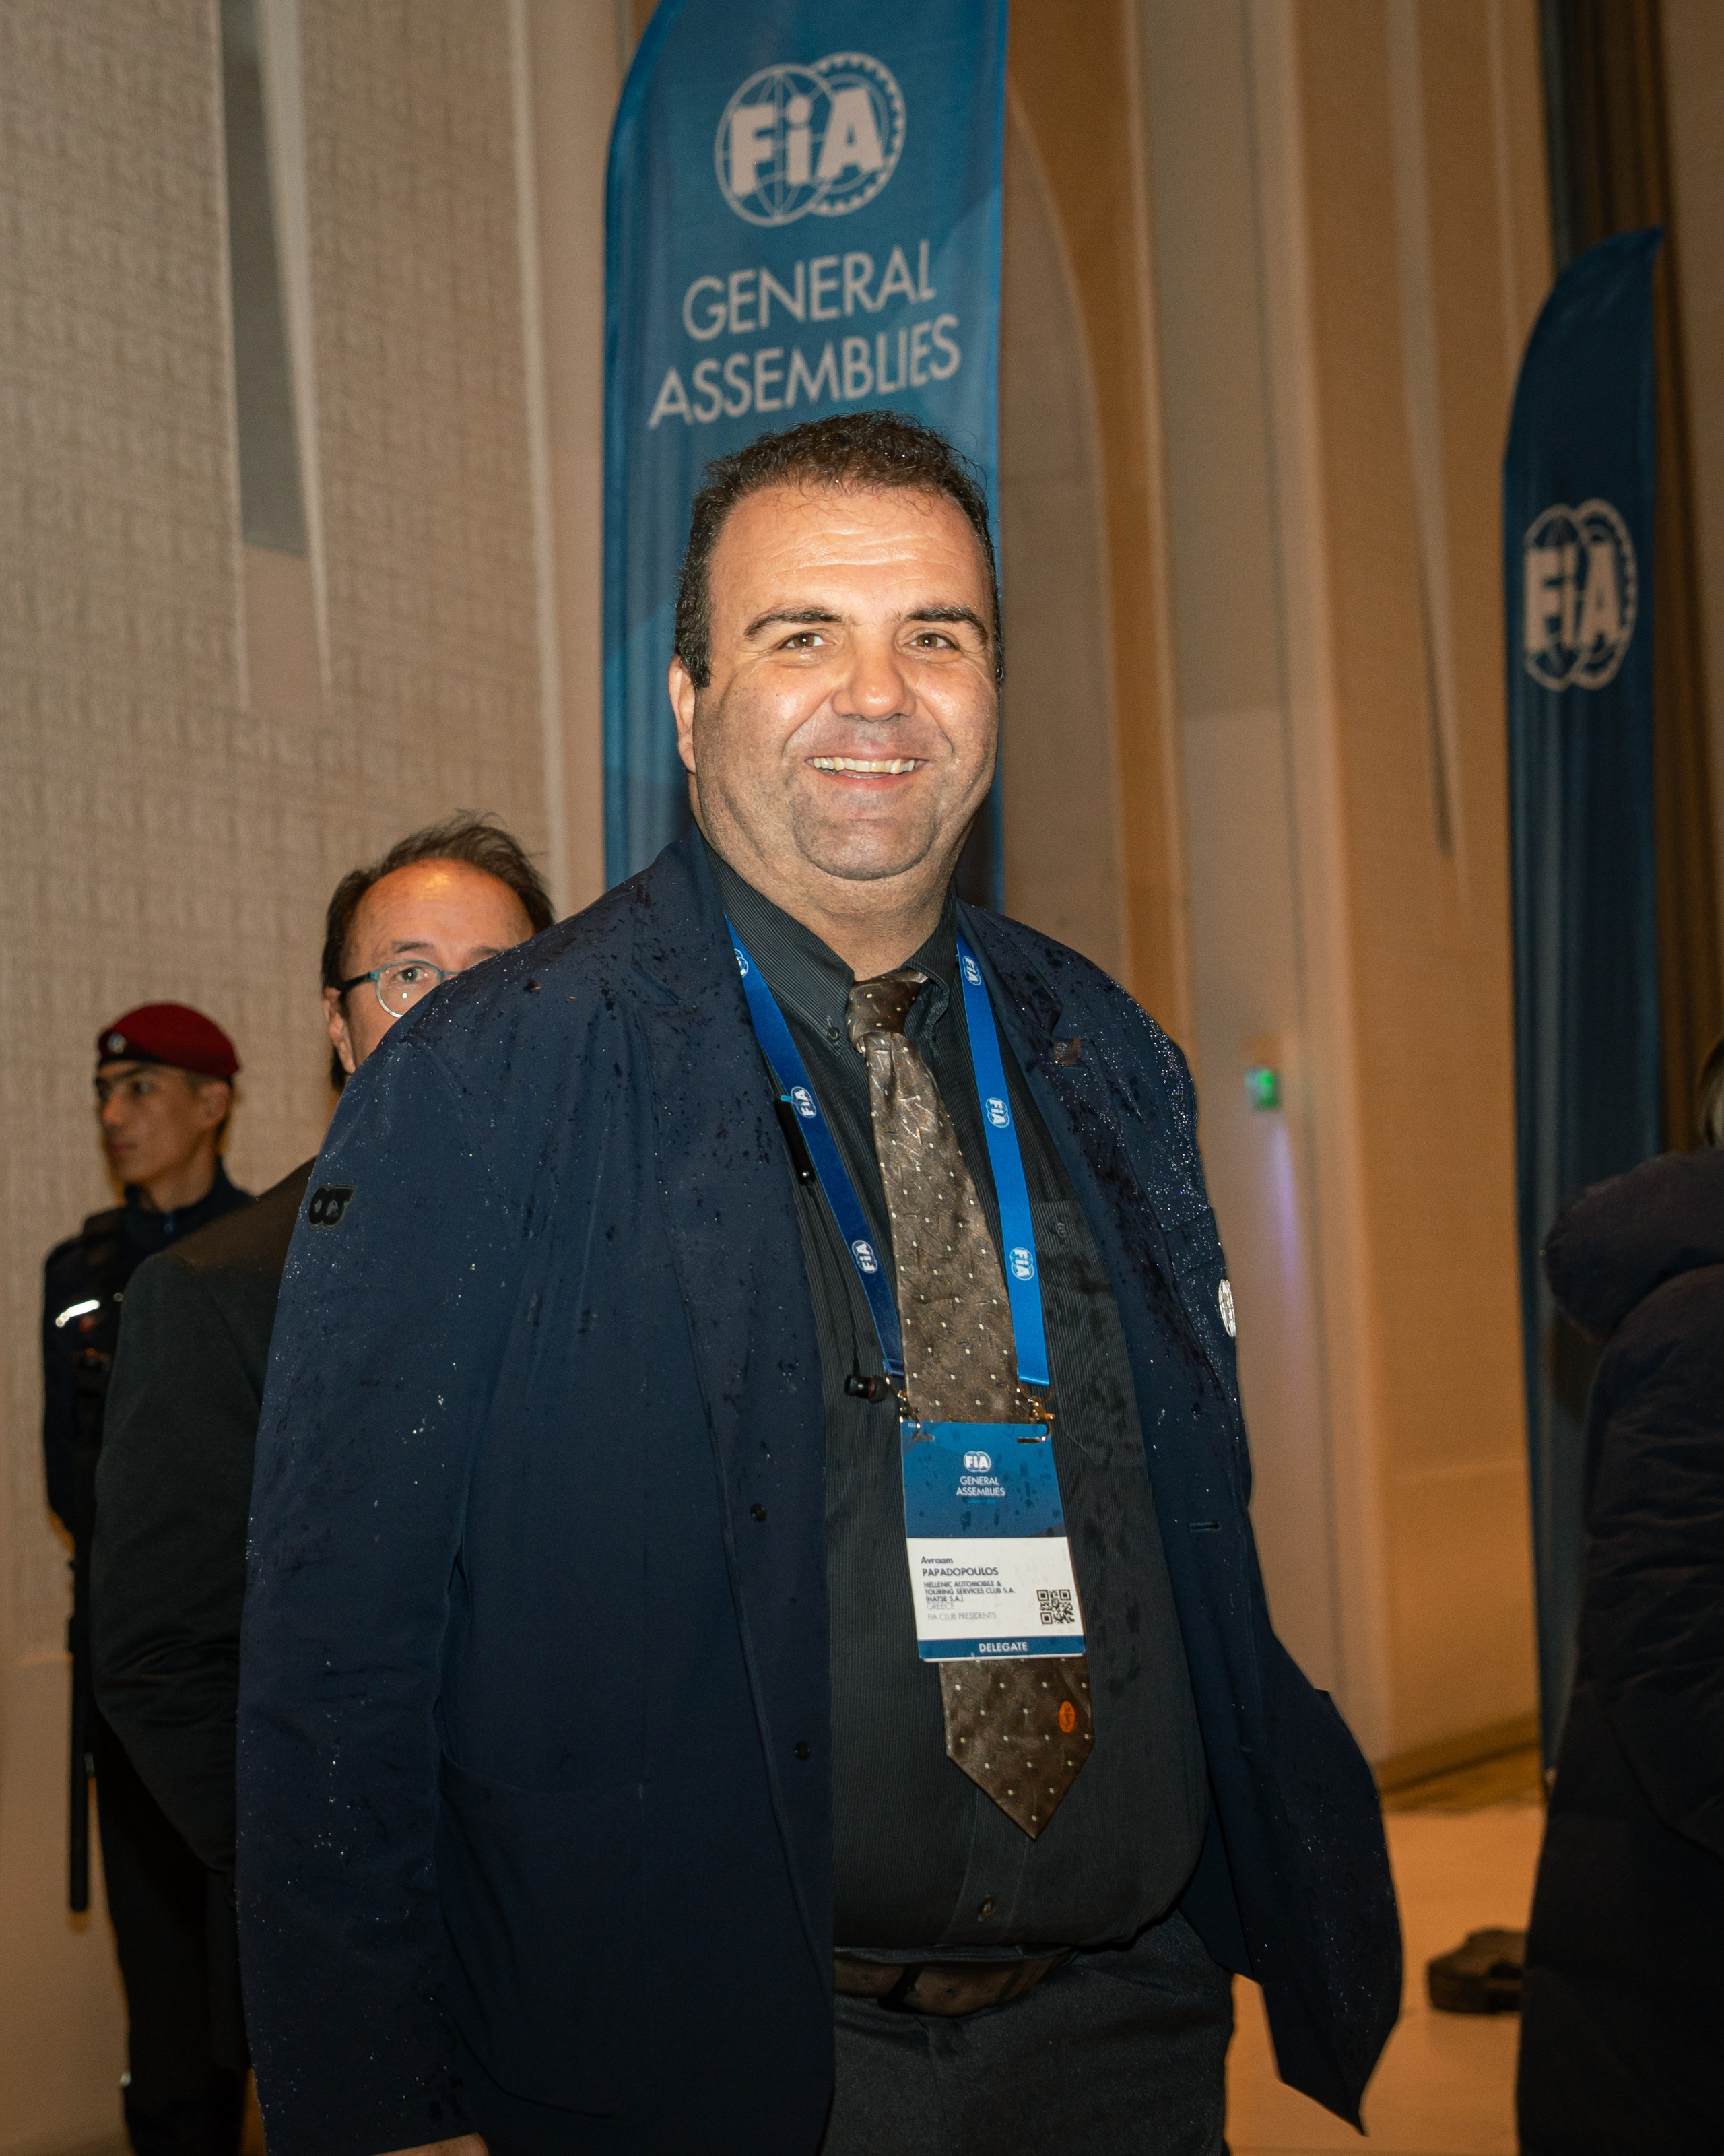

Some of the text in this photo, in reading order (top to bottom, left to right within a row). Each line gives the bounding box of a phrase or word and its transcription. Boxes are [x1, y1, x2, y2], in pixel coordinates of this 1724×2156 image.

[682, 238, 937, 342] GENERAL
[648, 313, 960, 430] ASSEMBLIES
[960, 1476, 999, 1486] GENERAL
[956, 1487, 1006, 1497] ASSEMBLIES
[921, 1555, 954, 1564] Avraam
[922, 1567, 999, 1577] PAPADOPOULOS
[926, 1602, 955, 1610] GREECE
[958, 1611, 997, 1620] PRESIDENTS
[979, 1641, 1028, 1654] DELEGATE
